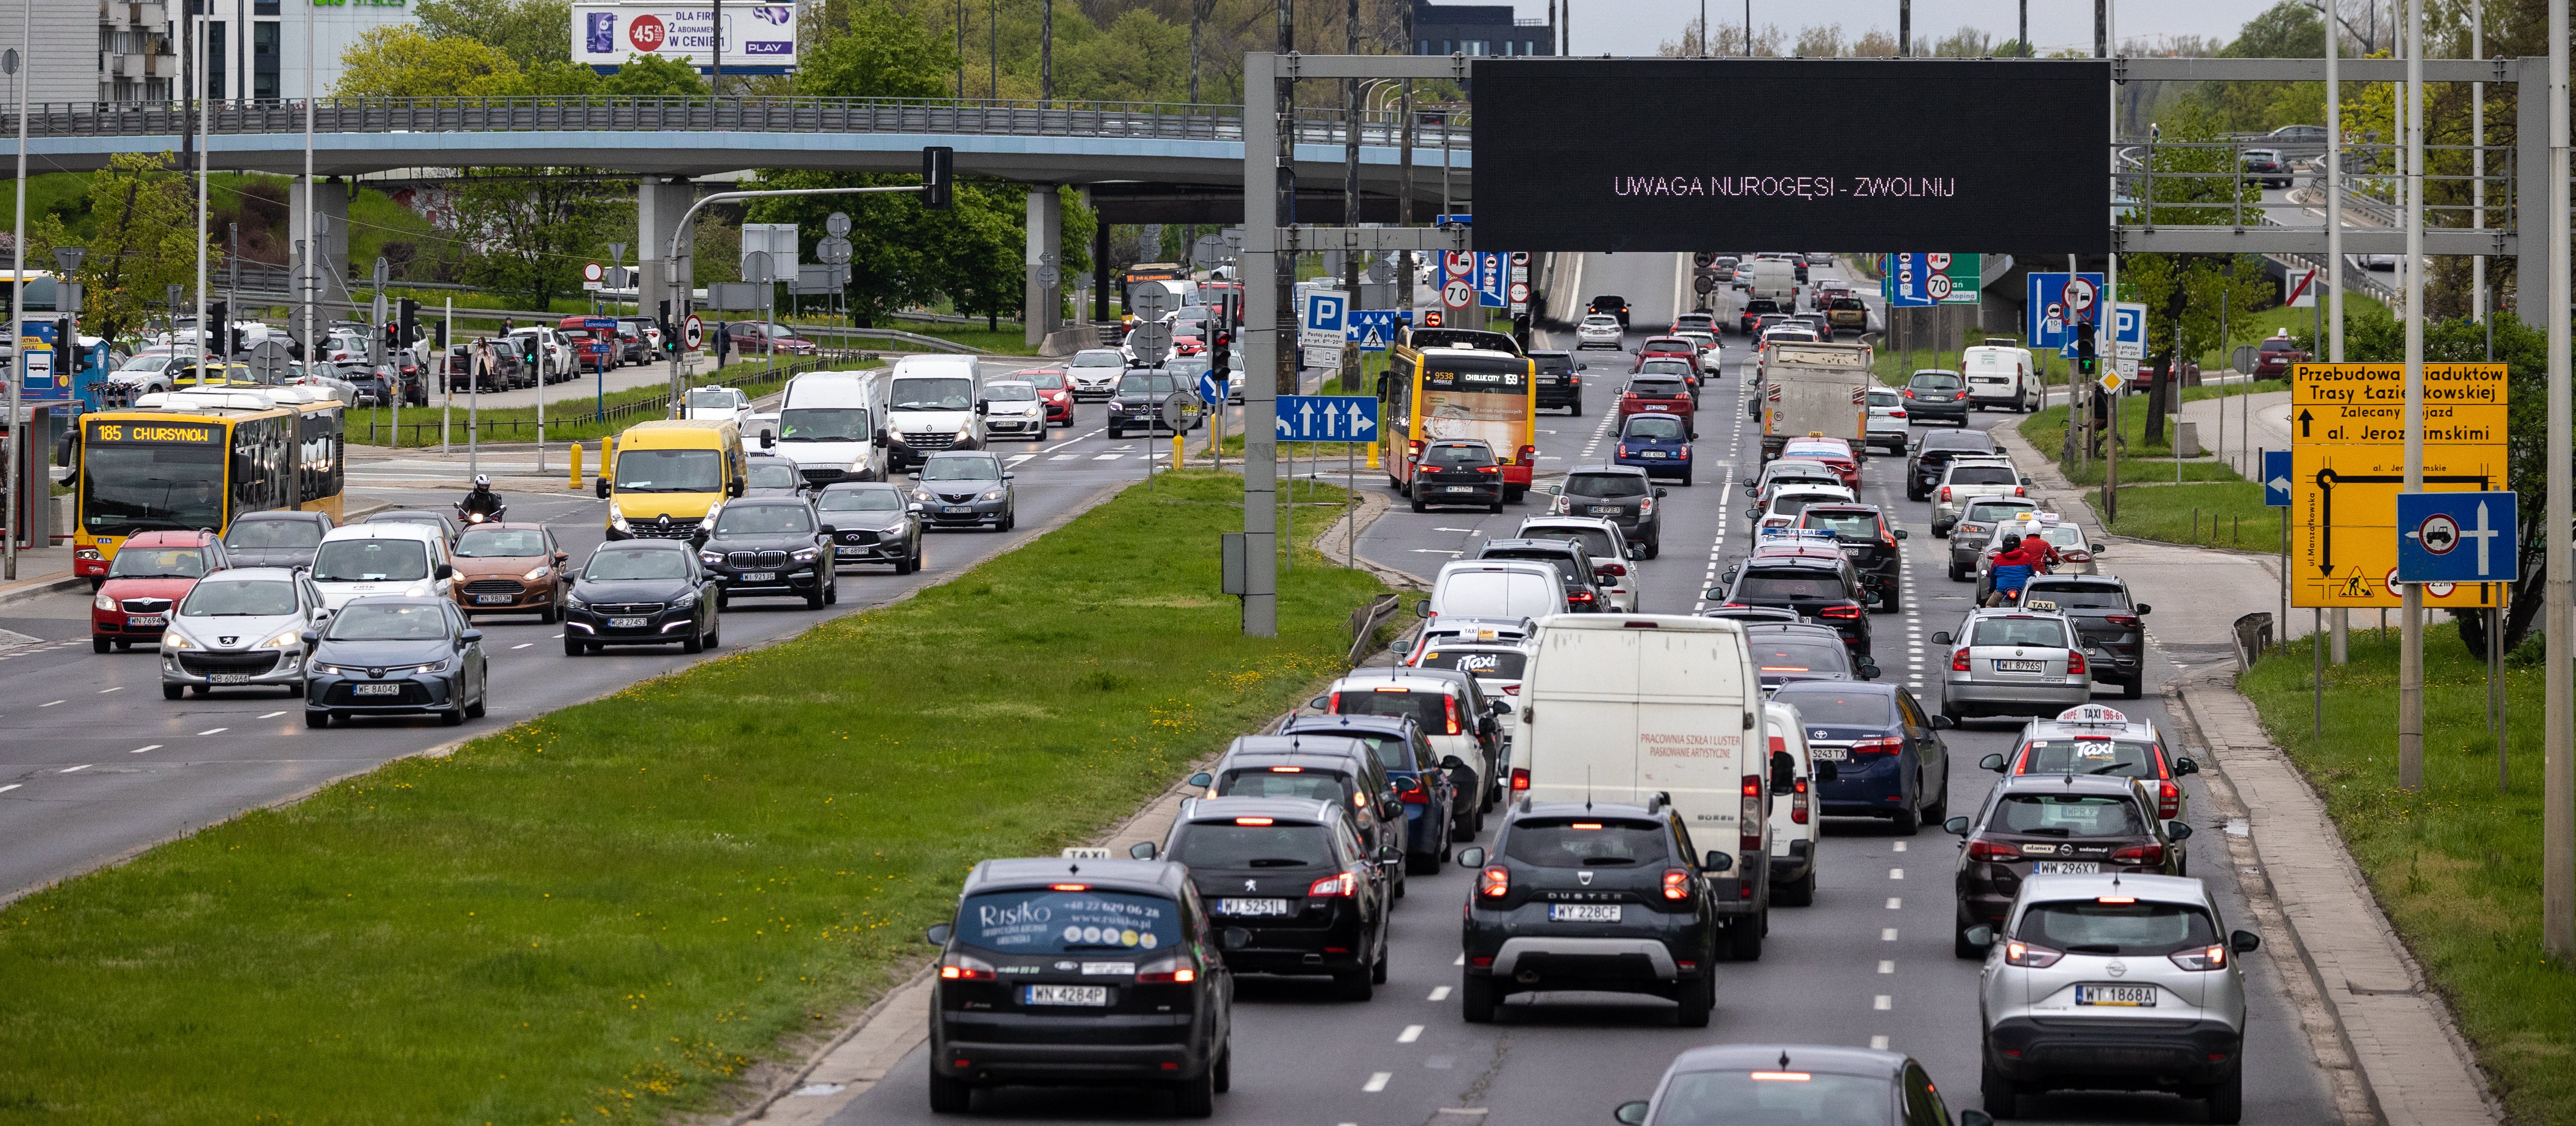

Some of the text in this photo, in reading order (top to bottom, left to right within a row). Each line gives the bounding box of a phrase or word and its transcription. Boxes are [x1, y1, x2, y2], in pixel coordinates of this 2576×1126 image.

[676, 12, 694, 20] DLA
[634, 25, 654, 42] 45
[669, 23, 675, 33] 2
[669, 37, 678, 47] W
[720, 37, 725, 47] 1
[1616, 177, 1704, 195] UWAGA
[1712, 177, 1833, 200] NUROGĘSI
[1854, 177, 1955, 195] ZWOLNIJ
[1931, 280, 1947, 293] 70
[1448, 288, 1468, 301] 70
[1316, 300, 1336, 326] P
[1435, 372, 1454, 380] 9538
[1504, 375, 1517, 384] 159
[2299, 366, 2503, 381] Przebudowa iaduktów
[2310, 385, 2495, 404] Trasy Łaziekowskiej
[2341, 406, 2453, 420] Zalecany jazd
[98, 425, 121, 440] 185
[2328, 426, 2490, 440] al. Jerozimskimi
[1457, 654, 1497, 671] iTaxi
[2002, 661, 2041, 670] WI 8796S
[225, 674, 248, 682] 6096A
[372, 685, 398, 693] 8A042
[2063, 709, 2123, 720] SUPE TAXI 196-61
[1641, 734, 1684, 745] PRACOWNIA
[1686, 734, 1708, 745] SZKŁA
[1714, 735, 1741, 746] LUSTER
[1650, 747, 1731, 758] PIASKOWANIE ARTYSTYCZNE
[1813, 750, 1846, 758] 5243 TX
[2074, 741, 2115, 757] Taxi
[1070, 850, 1106, 859] TAXI
[2042, 863, 2097, 874] WW 296XY
[1225, 902, 1284, 914] WJ 5251L
[1559, 906, 1617, 918] WY 228CF
[1036, 988, 1103, 1001] WN 4284P
[2086, 988, 2152, 1002] WT 1868A
